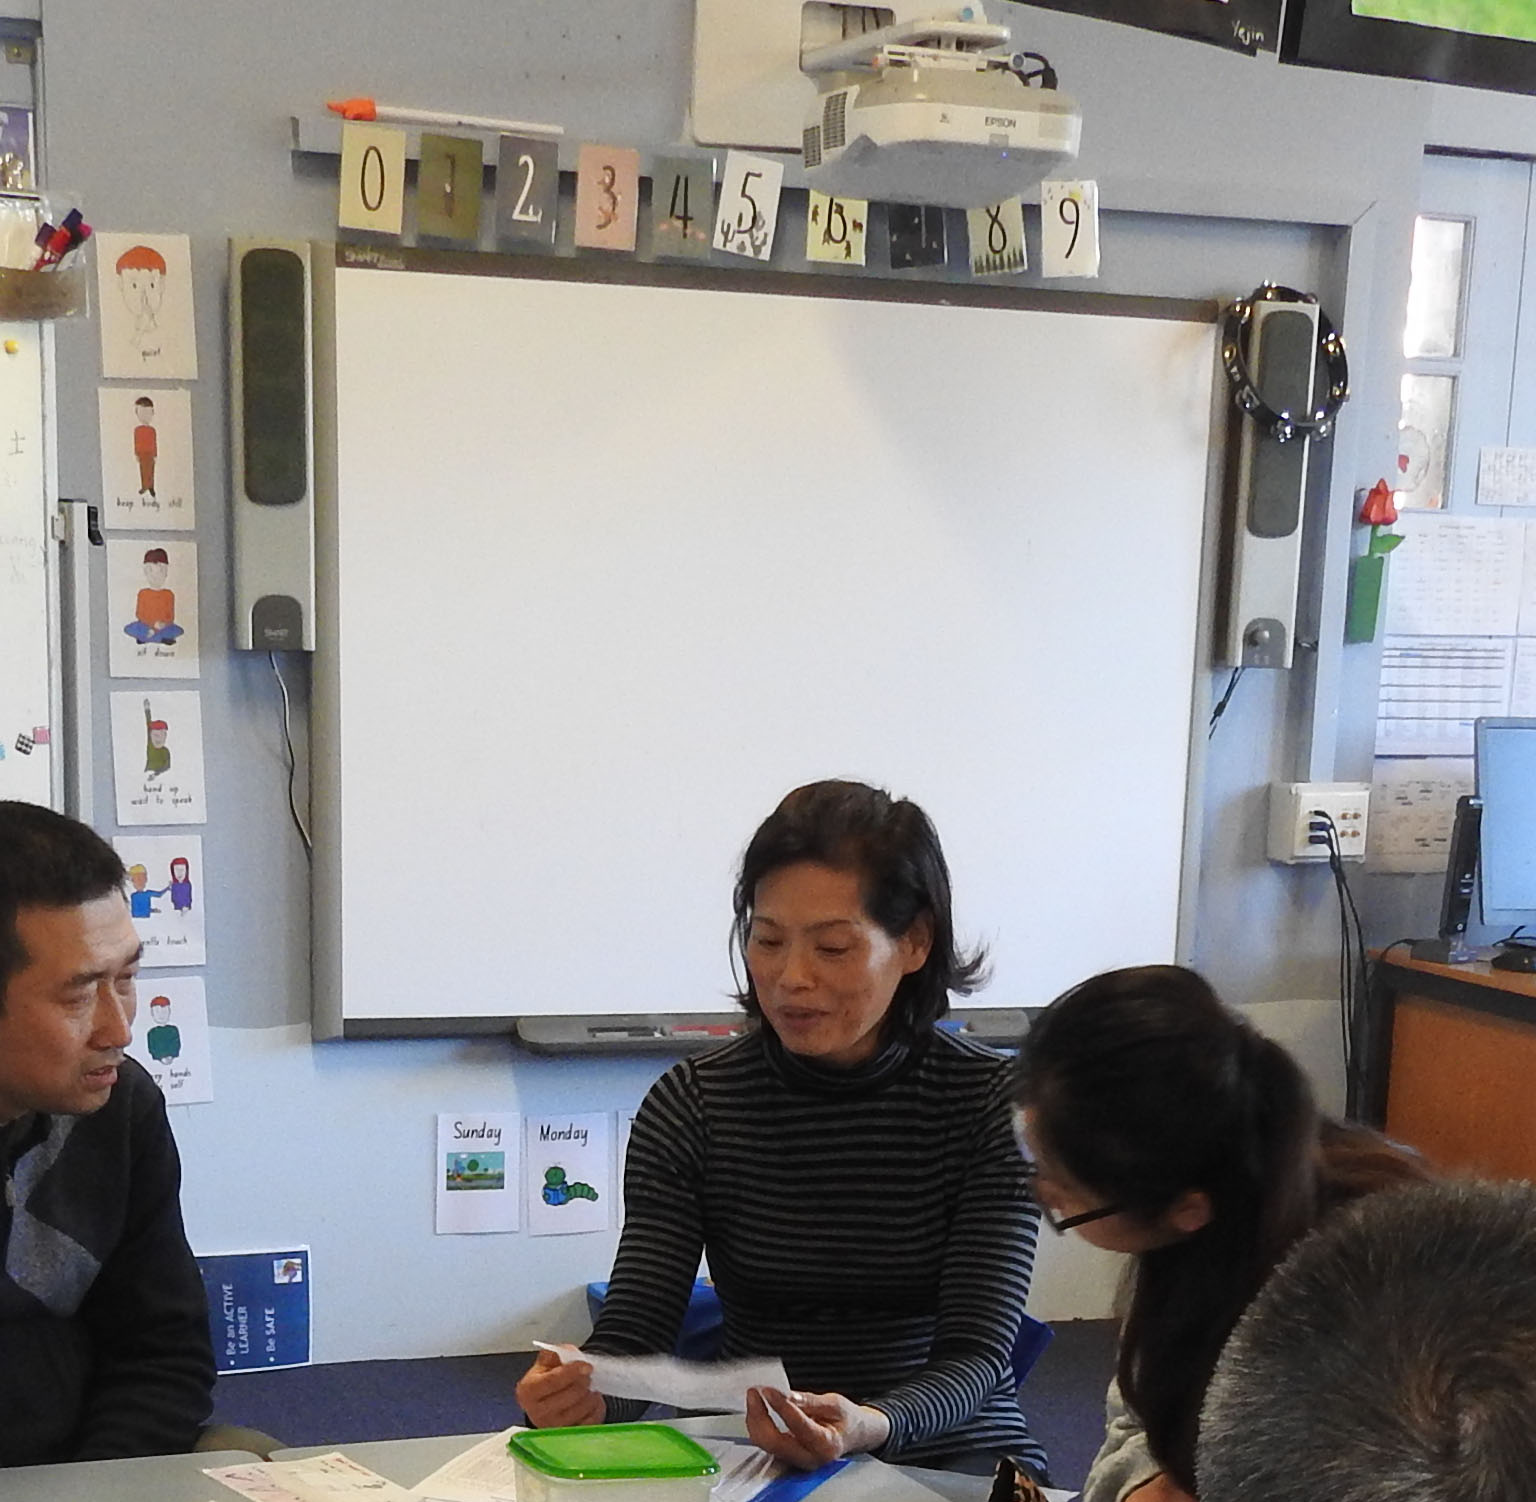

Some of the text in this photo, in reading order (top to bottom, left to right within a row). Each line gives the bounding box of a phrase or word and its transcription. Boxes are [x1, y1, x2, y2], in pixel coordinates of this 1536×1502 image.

[1231, 20, 1265, 45] Yejin
[985, 116, 1017, 128] EPSON
[361, 145, 385, 212] 0
[511, 154, 544, 223] 2
[595, 165, 622, 230] 3
[669, 174, 695, 239] 4
[737, 171, 763, 234] 5
[1059, 197, 1081, 259] 9
[454, 1121, 502, 1146] Sunday
[539, 1123, 588, 1147] Monday
[222, 1283, 236, 1356] Be an ACTIVE
[237, 1305, 249, 1355] LEARNER
[264, 1306, 276, 1352] Be SAFE
